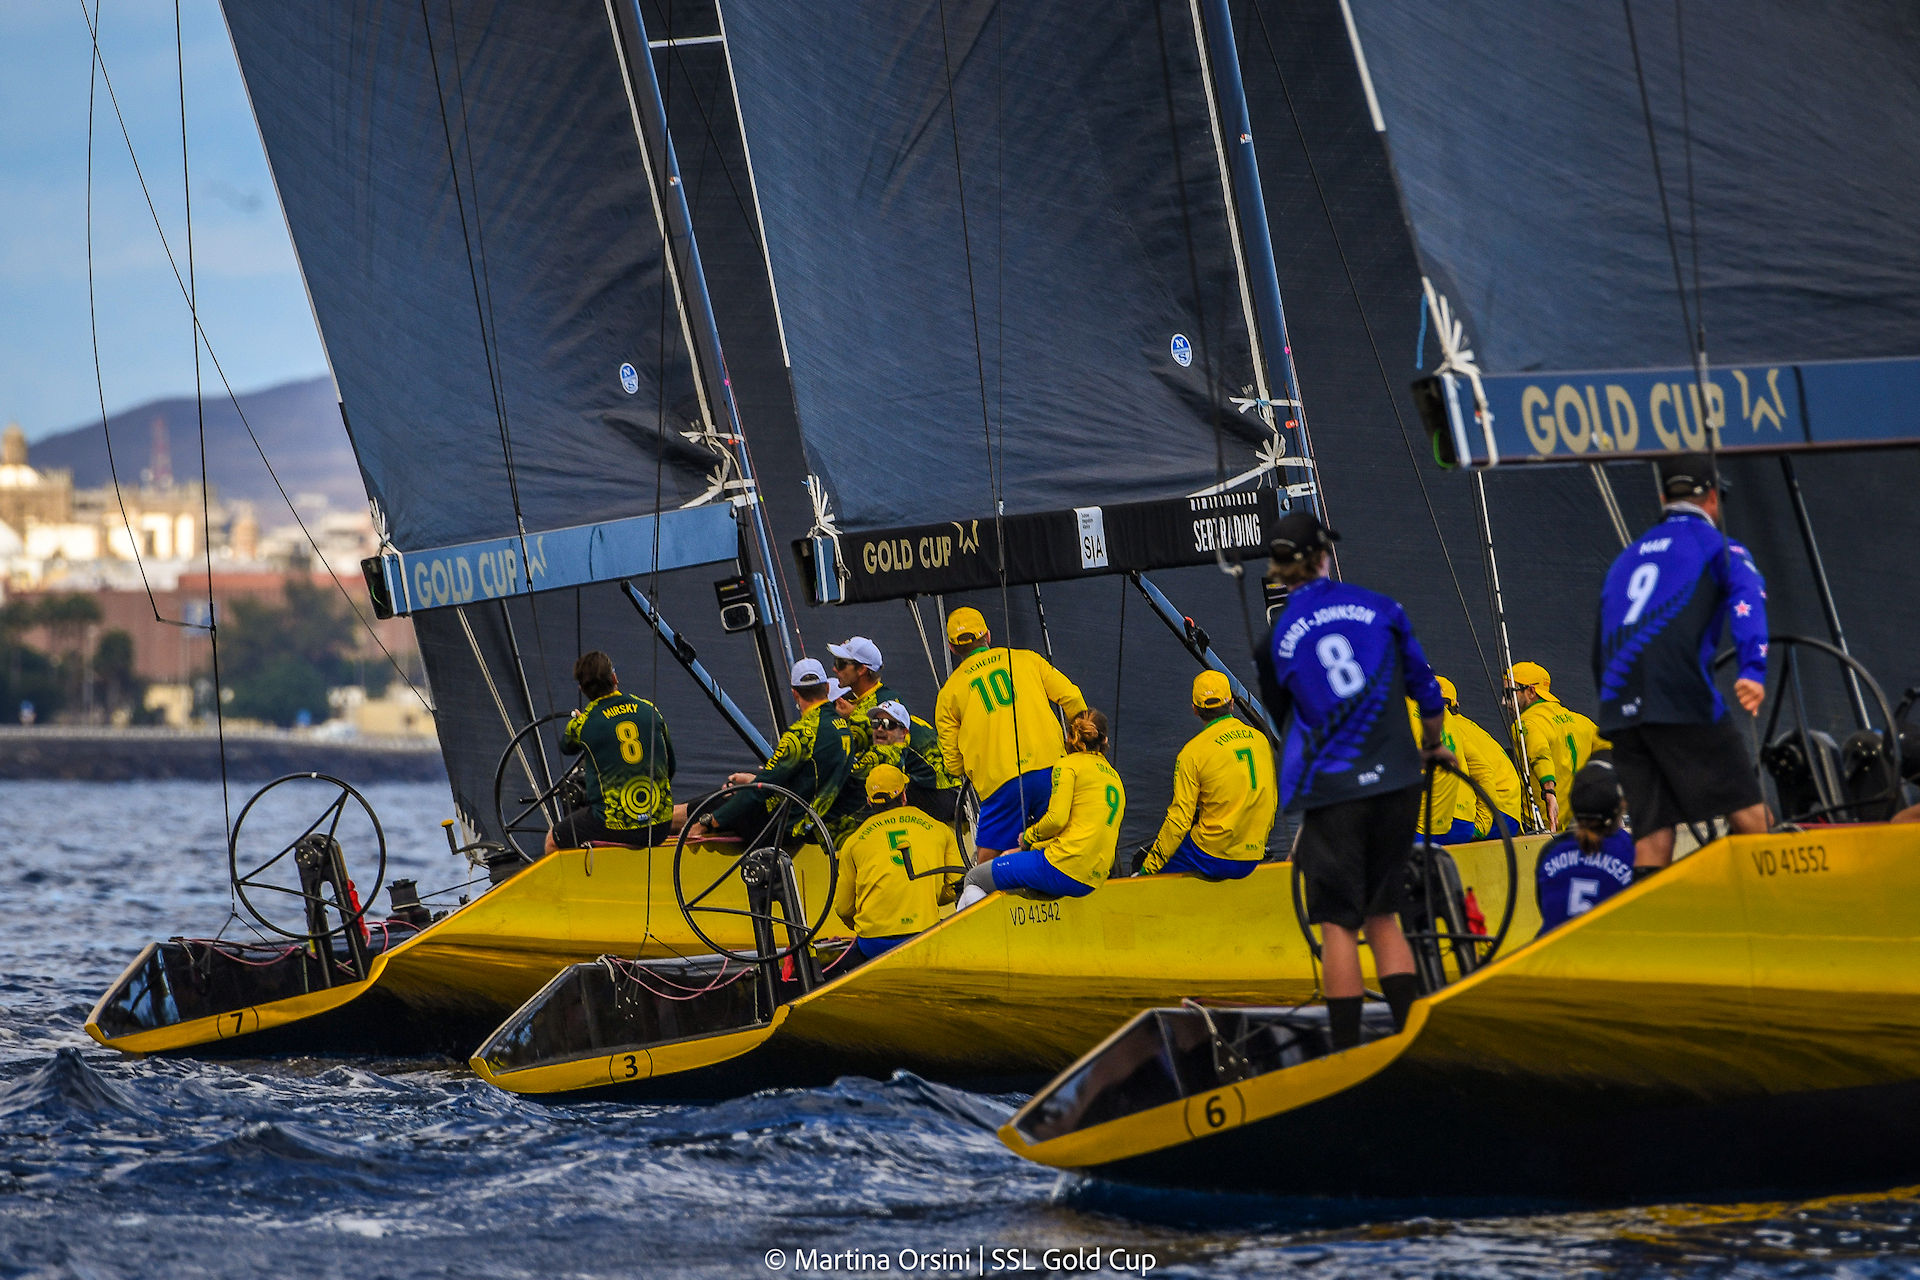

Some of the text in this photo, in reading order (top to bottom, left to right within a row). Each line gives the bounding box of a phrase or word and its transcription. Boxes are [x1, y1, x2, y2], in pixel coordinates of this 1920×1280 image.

[1521, 382, 1726, 457] GOLD CUP
[1193, 513, 1261, 552] SERTRADING
[862, 535, 952, 575] GOLD CUP
[414, 548, 518, 609] GOLD CUP
[1621, 562, 1660, 626] 9
[1316, 632, 1366, 699] 8
[602, 703, 639, 719] MIRSKY
[968, 668, 1017, 715] 10
[615, 720, 644, 765] 8
[1213, 728, 1255, 747] FONSECA
[1233, 747, 1257, 792] 7
[898, 815, 934, 831] BORGES
[1105, 784, 1120, 827] 9
[886, 828, 913, 866] 5
[1751, 844, 1829, 877] VD 41552
[1009, 901, 1062, 927] VD 41542
[1566, 876, 1600, 917] 5
[230, 1011, 243, 1034] 7
[623, 1054, 639, 1079] 3
[1205, 1094, 1227, 1129] 6
